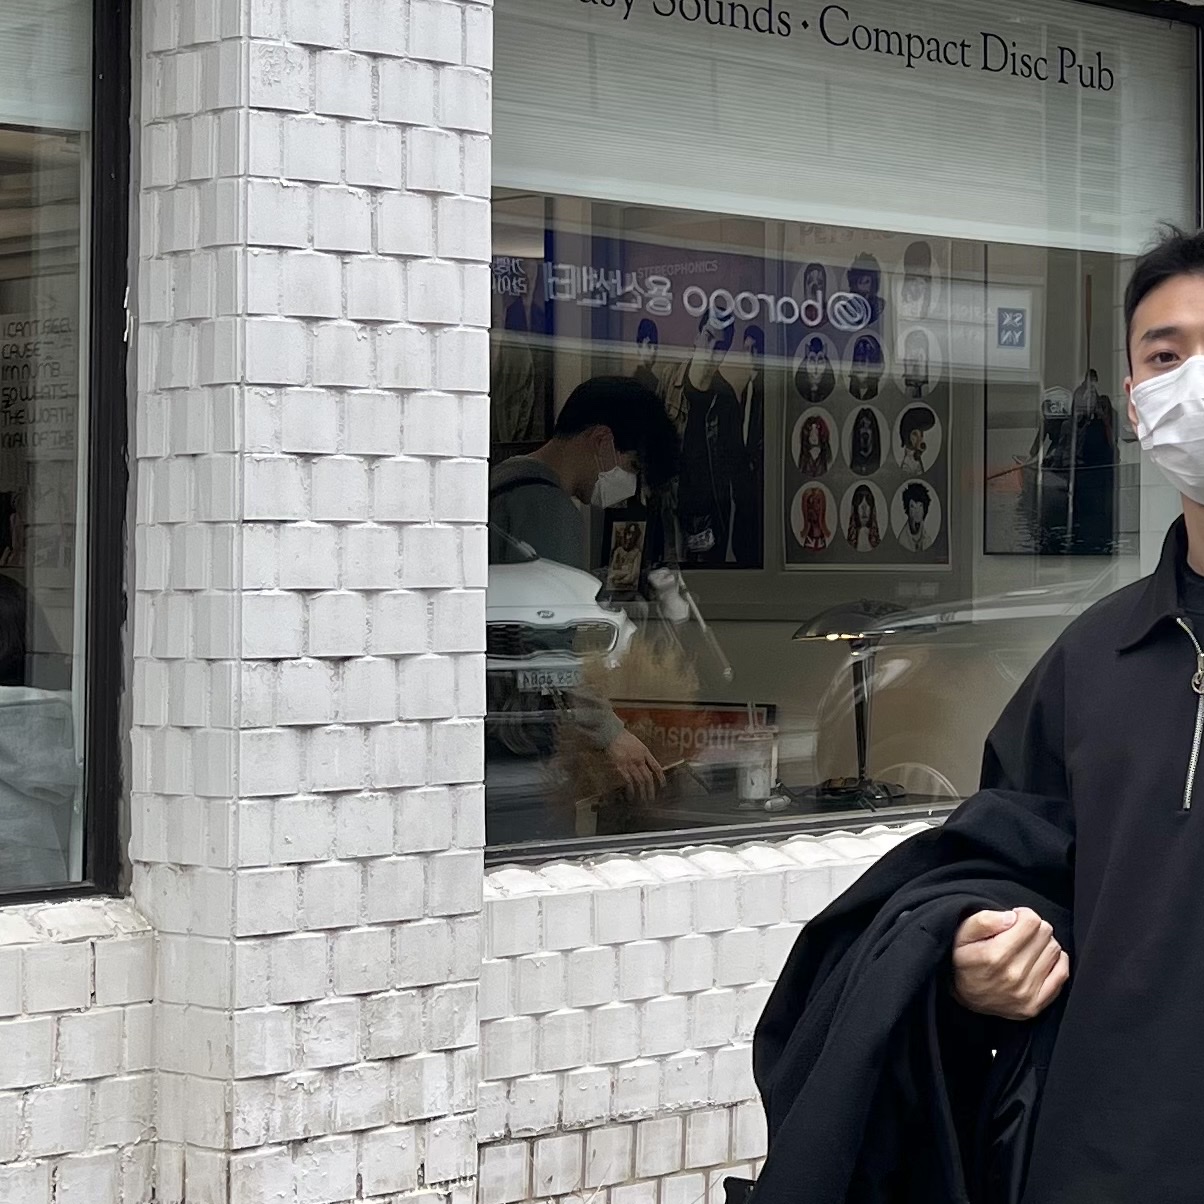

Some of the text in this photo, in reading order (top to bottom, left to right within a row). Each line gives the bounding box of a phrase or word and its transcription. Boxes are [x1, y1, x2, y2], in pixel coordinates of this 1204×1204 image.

[818, 4, 972, 69] Compact
[980, 31, 1049, 81] Disc
[1057, 46, 1115, 91] Pub
